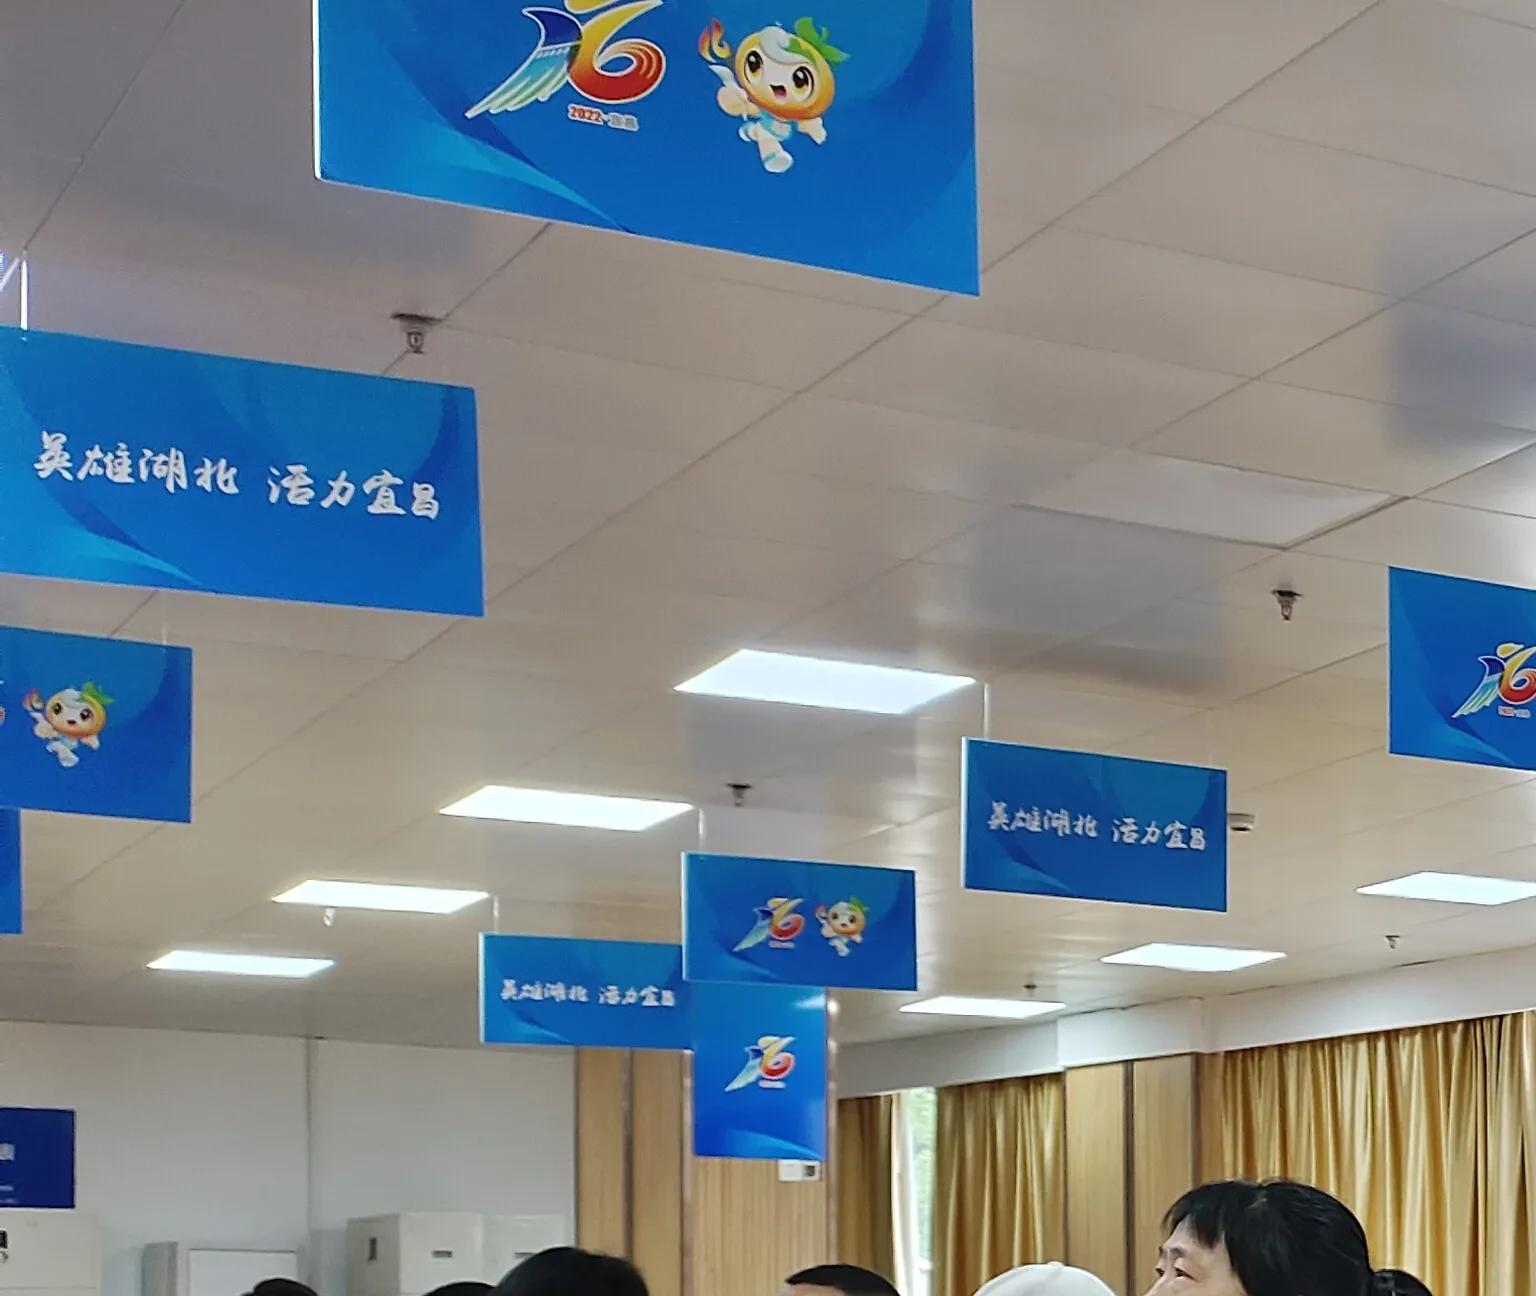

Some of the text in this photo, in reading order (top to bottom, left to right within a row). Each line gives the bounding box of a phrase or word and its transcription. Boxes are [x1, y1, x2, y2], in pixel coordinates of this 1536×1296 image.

[33, 430, 441, 520] 英雄湖北 活力宜昌
[987, 800, 1206, 850] 英雄湖北 活力宜昌
